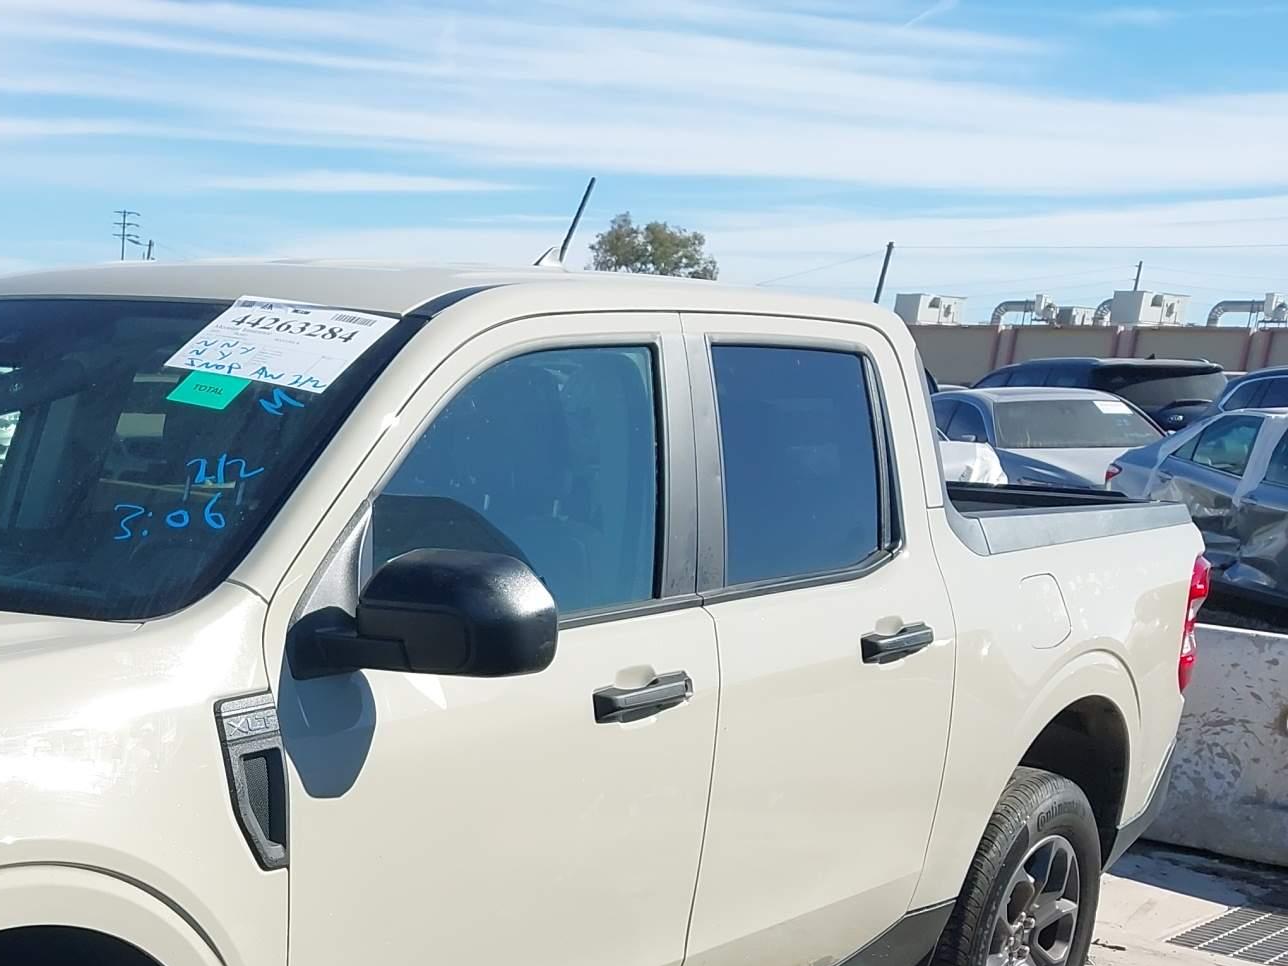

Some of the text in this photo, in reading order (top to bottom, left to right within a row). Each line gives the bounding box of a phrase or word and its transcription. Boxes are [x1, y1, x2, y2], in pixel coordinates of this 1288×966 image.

[232, 314, 359, 342] 44263284
[192, 383, 223, 396] TOTAL
[227, 711, 275, 736] XLT
